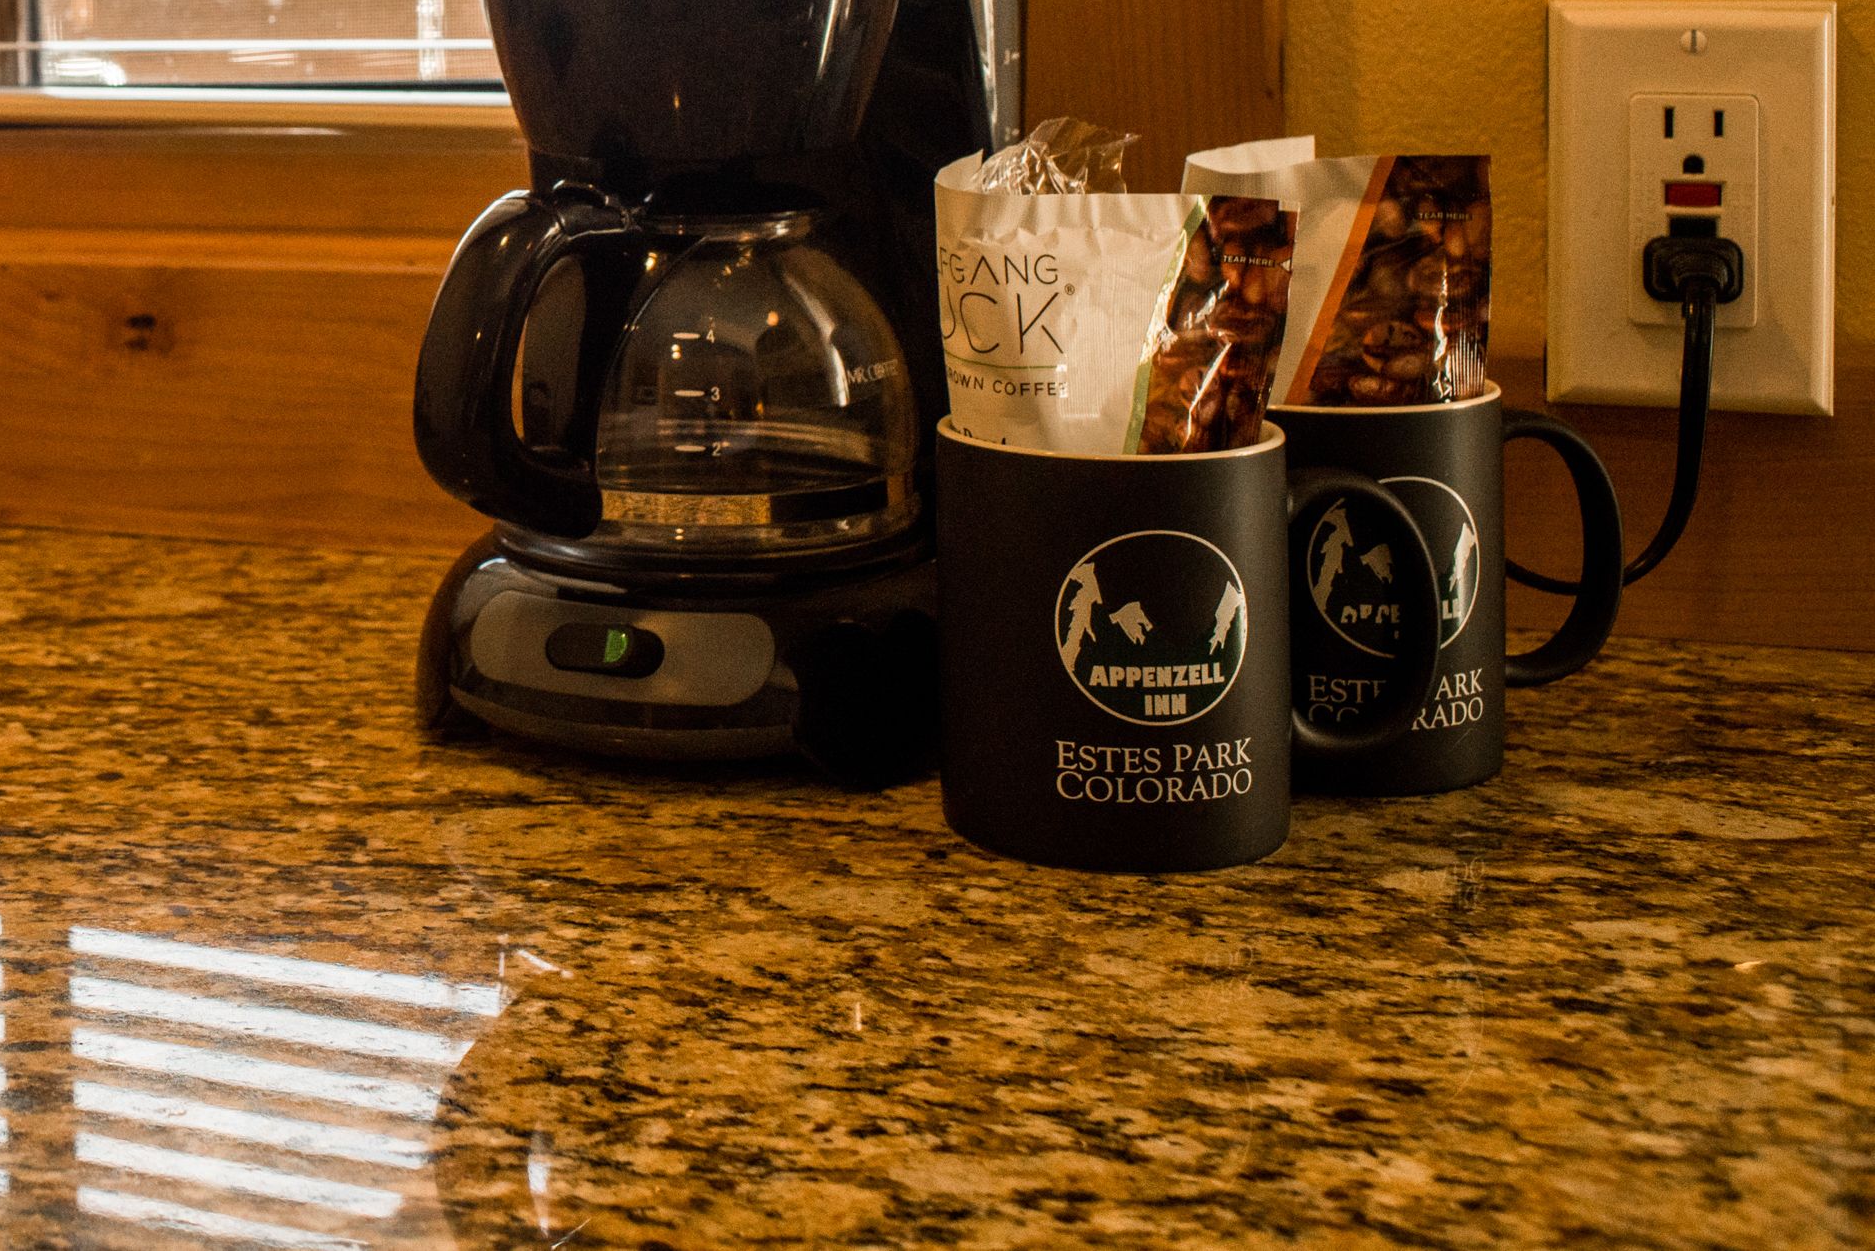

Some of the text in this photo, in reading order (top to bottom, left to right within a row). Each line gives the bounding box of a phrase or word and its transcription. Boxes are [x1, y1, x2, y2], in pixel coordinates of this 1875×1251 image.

[1223, 255, 1273, 267] TEAR HERE
[706, 330, 715, 343] 4
[710, 386, 720, 401] 3
[711, 441, 721, 456] 2
[1089, 662, 1225, 688] APPENZELL
[1434, 668, 1483, 700] ARK
[1144, 693, 1187, 716] INN
[1056, 737, 1252, 774] ESTES PARK
[1056, 768, 1252, 804] COLORADO
